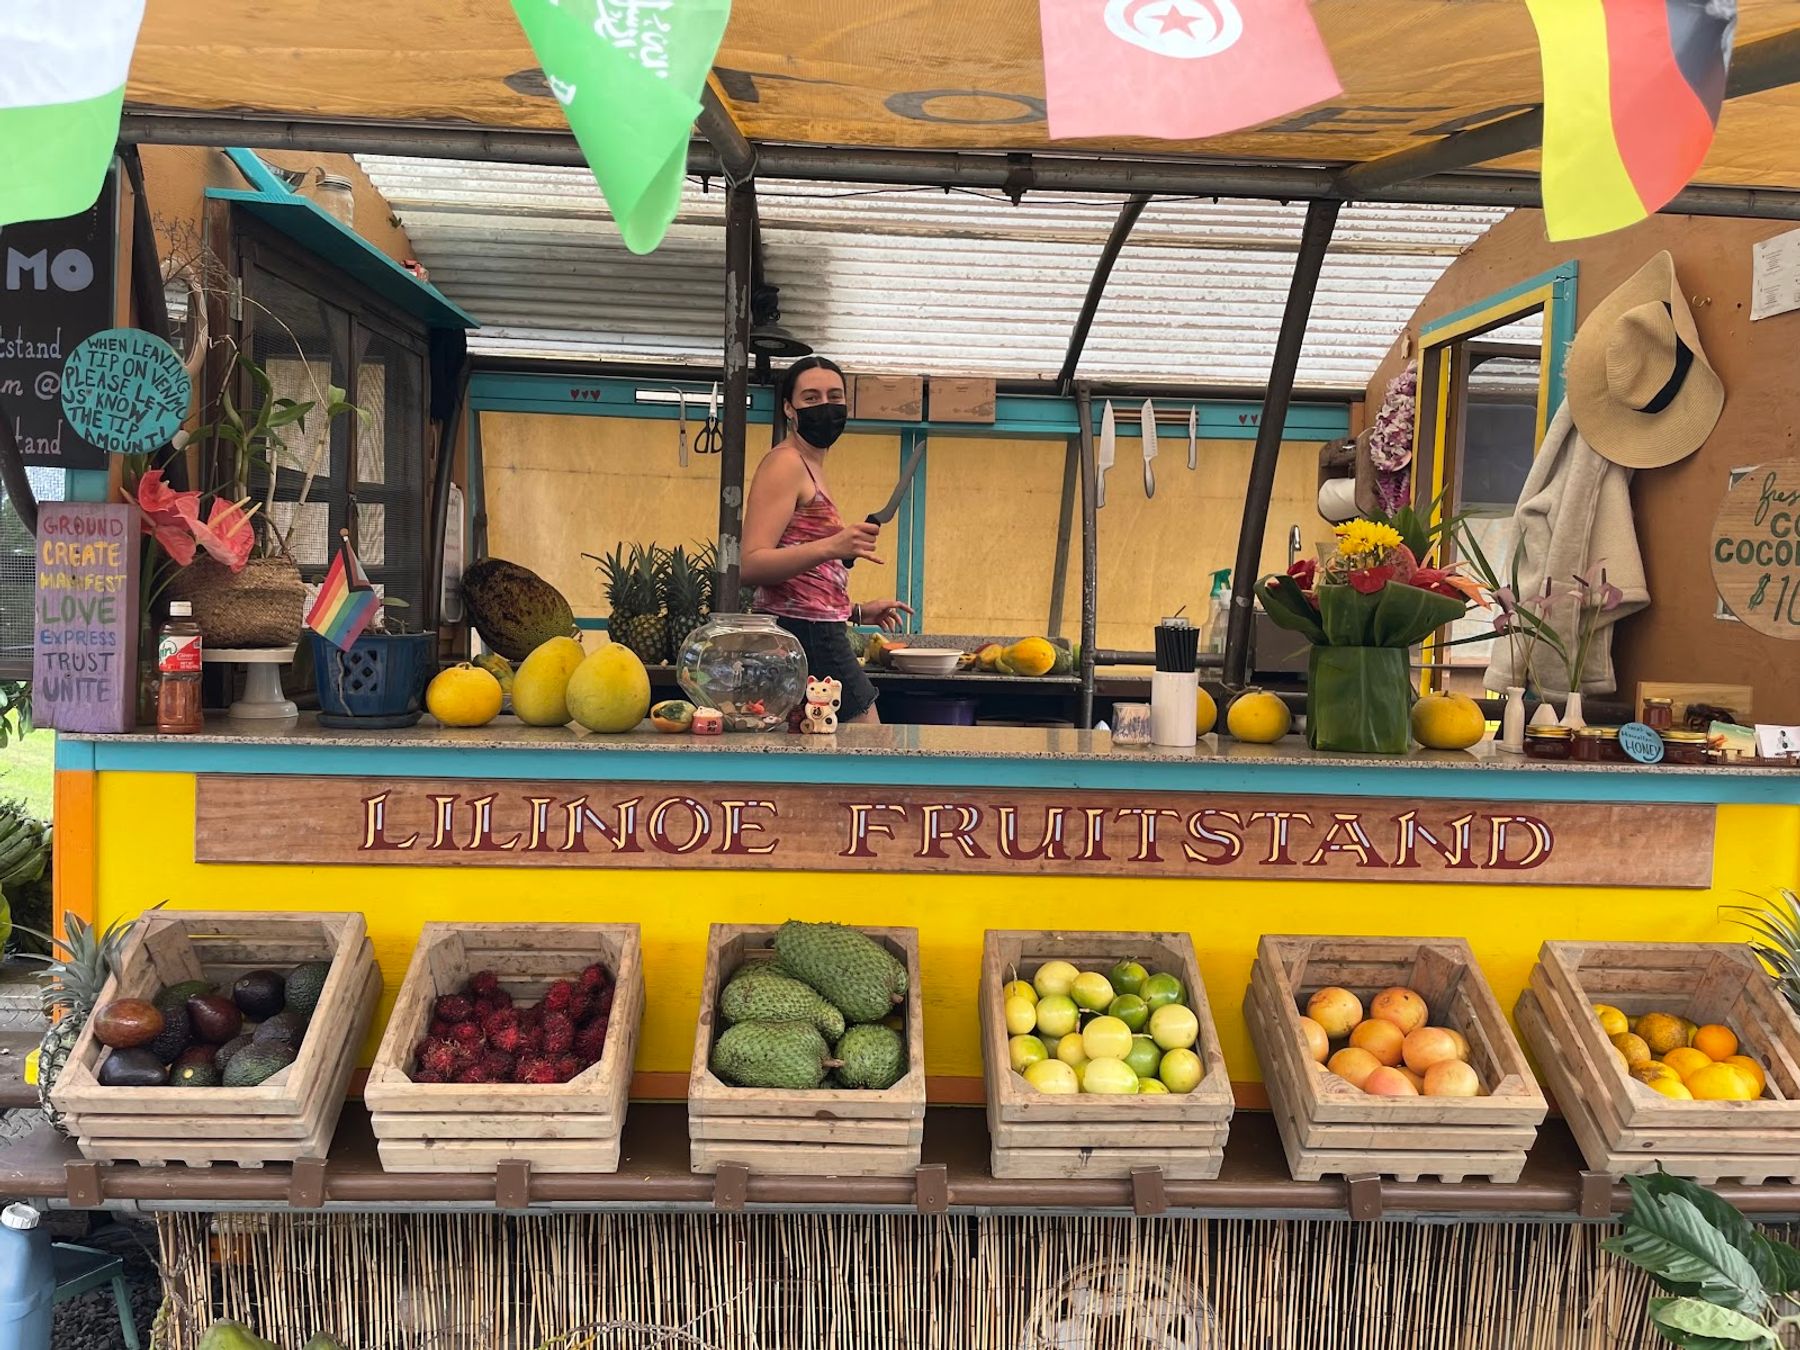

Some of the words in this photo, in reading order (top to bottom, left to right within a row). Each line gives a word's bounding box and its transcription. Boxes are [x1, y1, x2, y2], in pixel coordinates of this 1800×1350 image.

[73, 349, 82, 362] A
[88, 350, 119, 372] TIP
[122, 358, 148, 380] ON
[87, 338, 127, 354] WHEN
[132, 340, 191, 394] LEAVING
[62, 388, 87, 405] US
[95, 392, 149, 423] KNOW
[65, 366, 131, 396] PLEASE
[134, 383, 170, 422] LET
[68, 406, 103, 429] THE
[107, 413, 140, 440] TIP
[43, 517, 124, 537] GROUND
[42, 541, 121, 568] CREATE
[42, 596, 117, 625] LOVE
[40, 630, 116, 646] EXPRESS
[42, 652, 115, 673] TRUST
[42, 677, 111, 703] UNITE
[1624, 739, 1661, 761] HONEY
[357, 789, 780, 856] LILINOE
[838, 802, 1556, 870] FRUITSTAND
